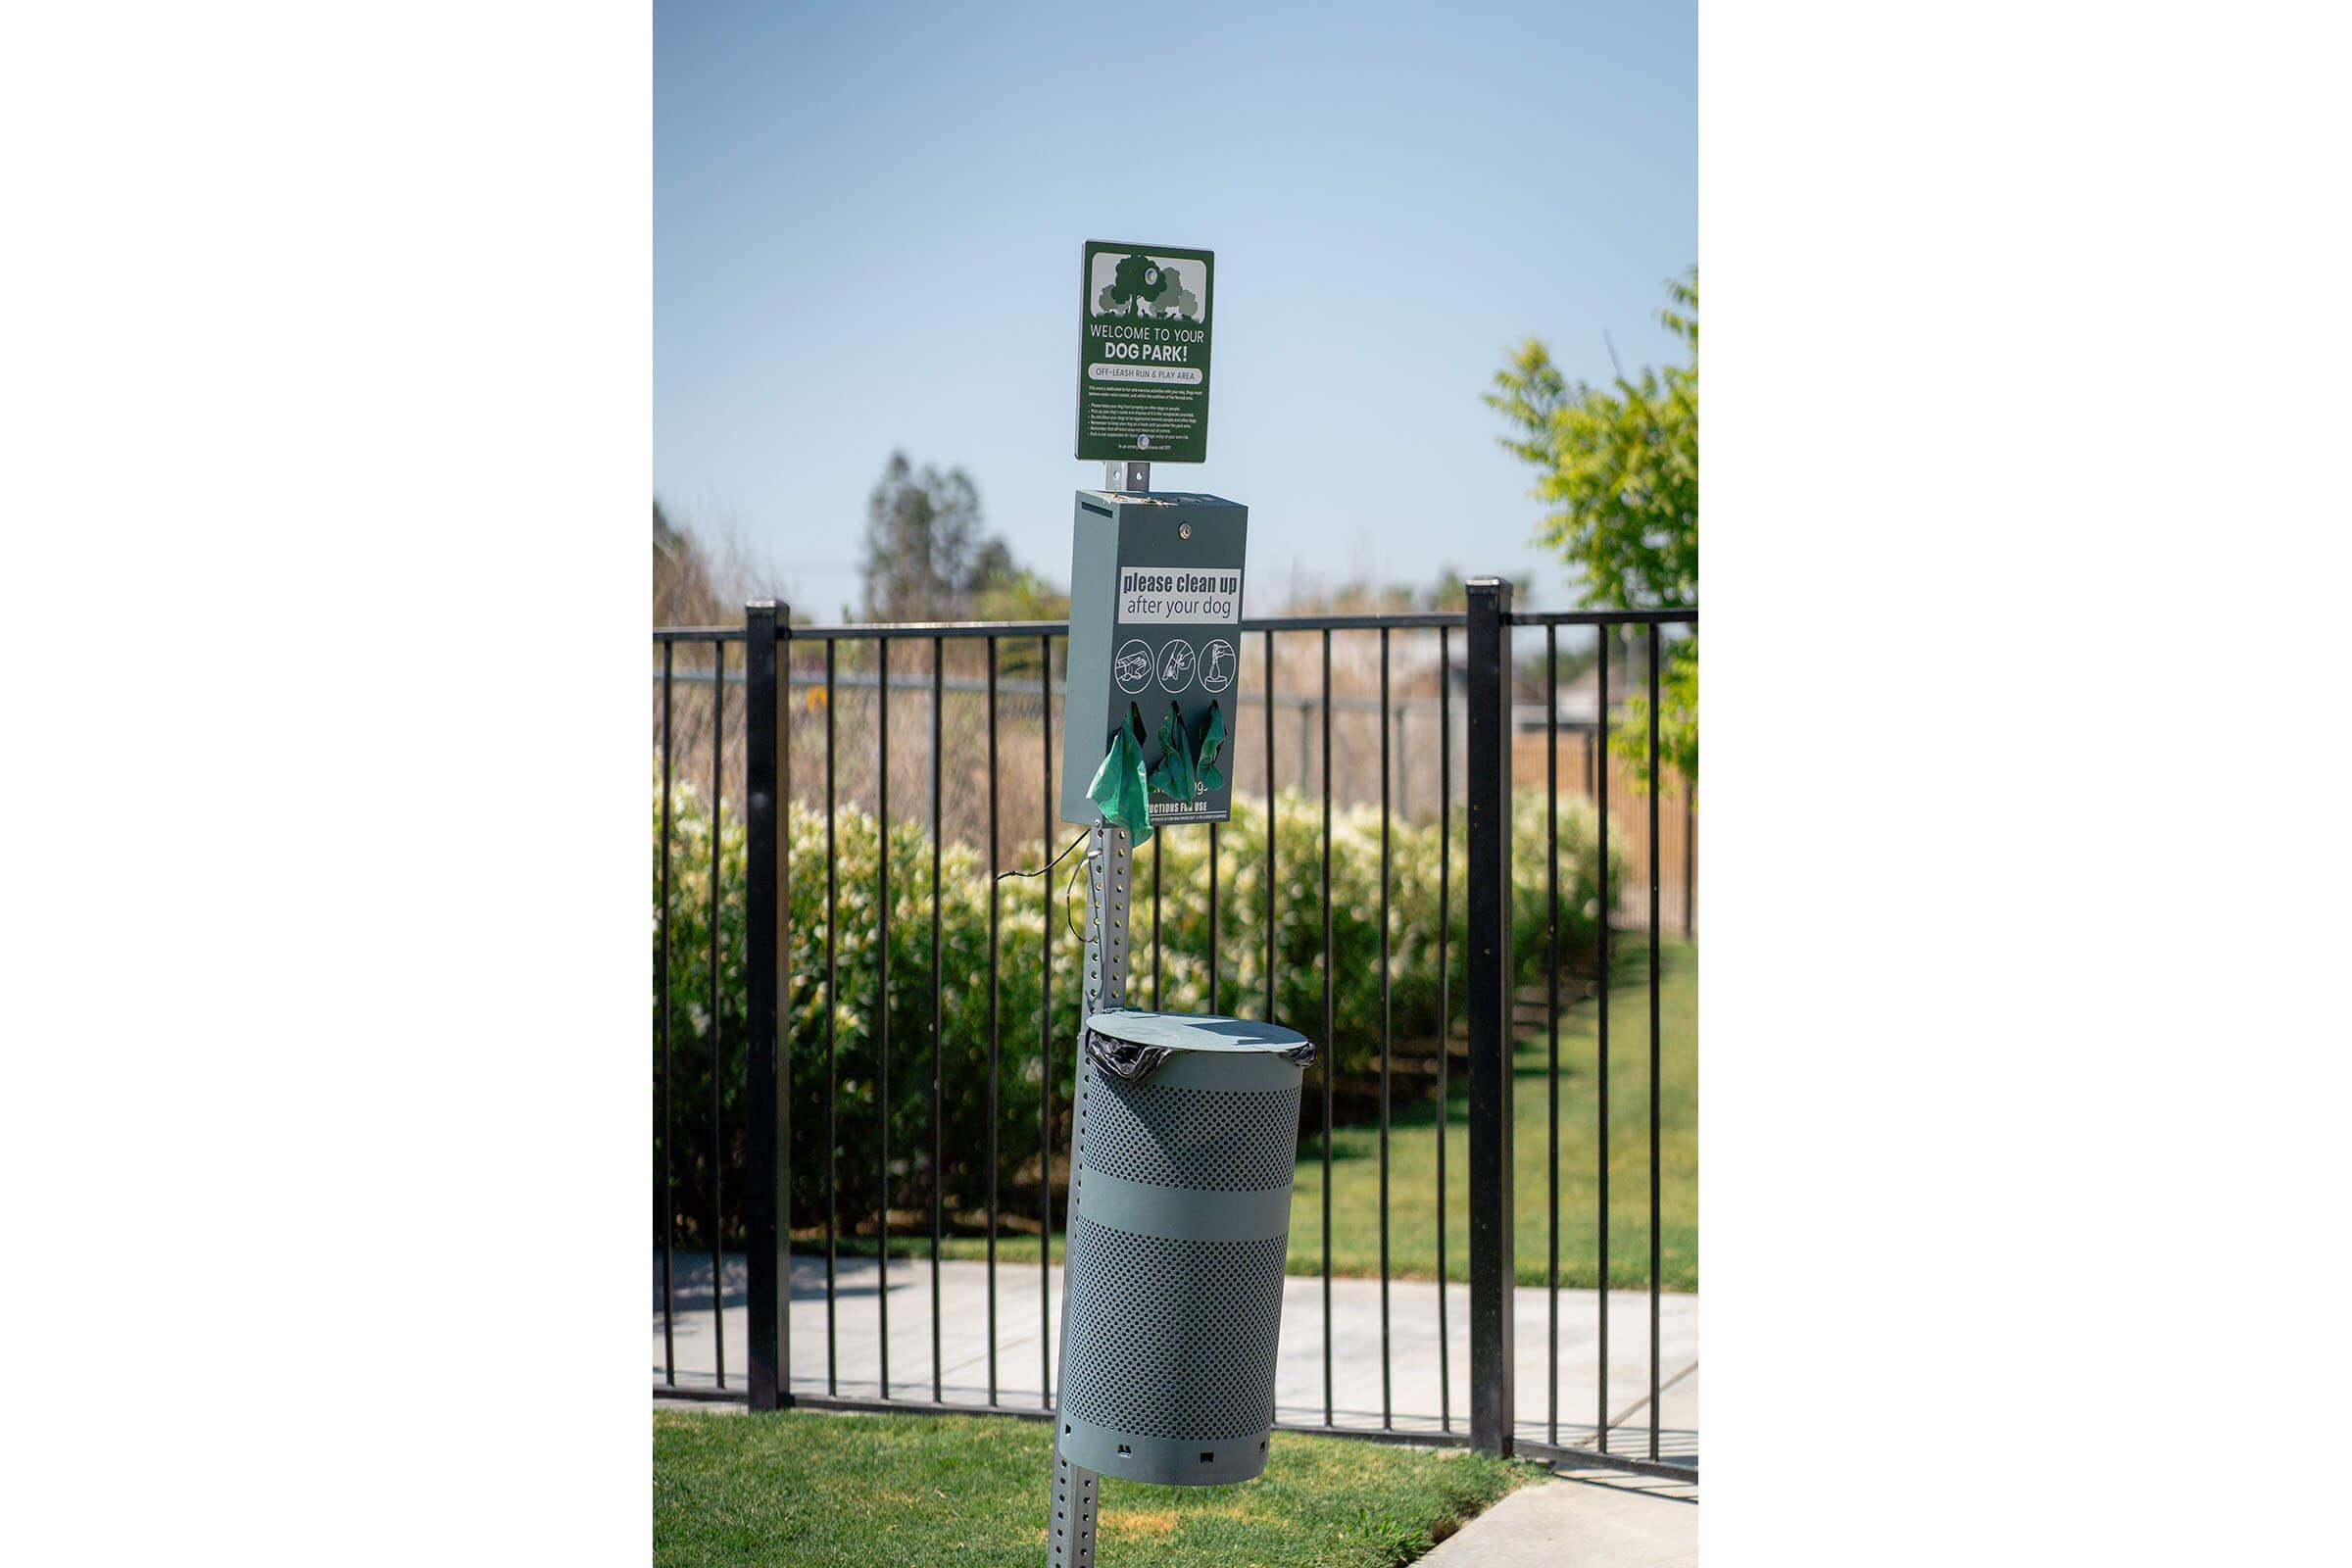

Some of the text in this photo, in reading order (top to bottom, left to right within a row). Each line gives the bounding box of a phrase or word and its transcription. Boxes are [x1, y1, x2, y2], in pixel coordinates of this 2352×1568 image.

[1090, 324, 1204, 343] WELCOME TO YOUR
[1104, 341, 1188, 362] DOG PARK!
[1096, 368, 1134, 377] OFF-LEASH
[1135, 369, 1150, 378] RUN
[1158, 370, 1176, 379] PLAY
[1176, 371, 1195, 380] AREA
[1123, 572, 1238, 595] please clean up
[1127, 595, 1231, 619] after your dog
[1194, 801, 1207, 811] USE
